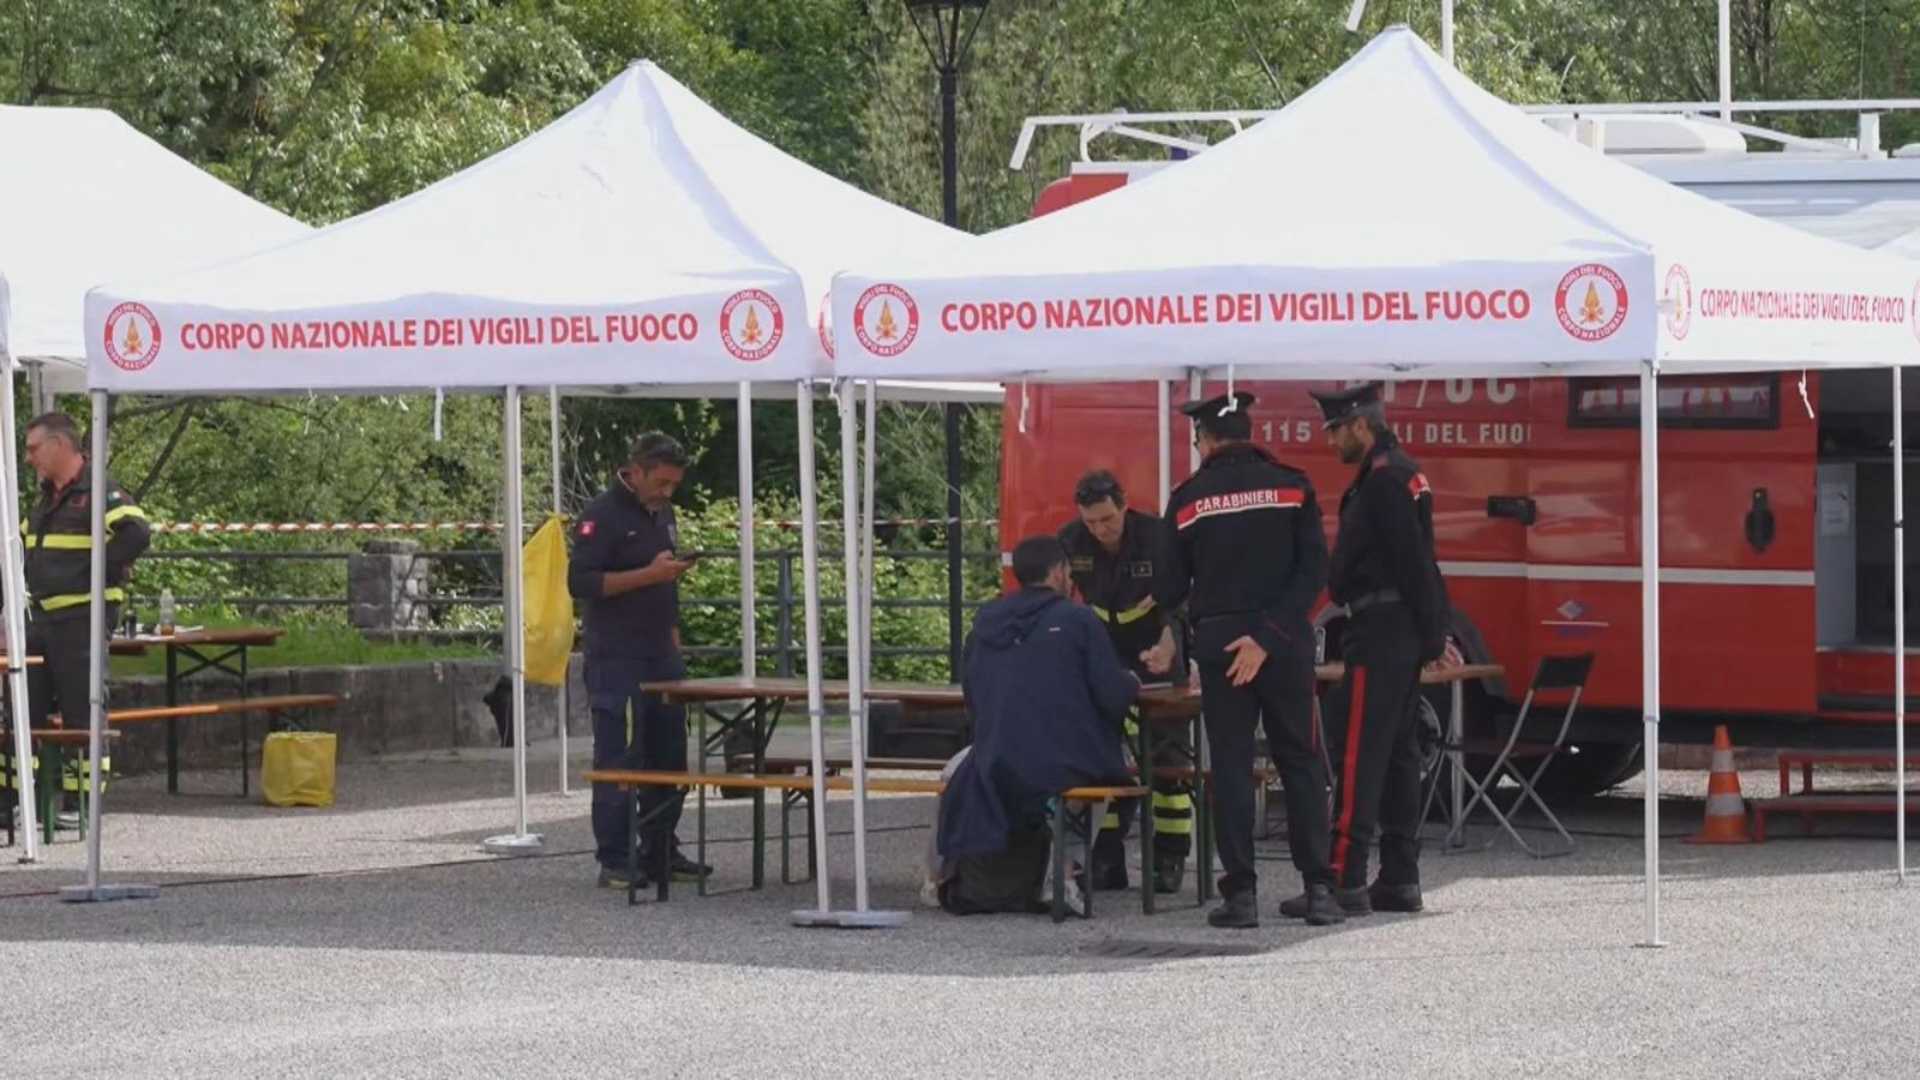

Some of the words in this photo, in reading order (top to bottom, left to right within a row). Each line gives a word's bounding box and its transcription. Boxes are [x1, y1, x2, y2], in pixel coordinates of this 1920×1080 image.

[942, 303, 1036, 331] CORPO
[1045, 295, 1208, 327] NAZIONALE
[1216, 294, 1260, 321] DEI
[1269, 293, 1354, 321] VIGILI
[1363, 292, 1418, 320] DEL
[1426, 289, 1530, 319] FUOCO
[1700, 288, 1738, 317] CORPO
[1741, 291, 1801, 319] NAZIONALE
[1803, 293, 1820, 319] DEI
[1822, 294, 1850, 321] VIGILI
[1852, 295, 1871, 321] DEL
[1872, 297, 1905, 323] FUOCO
[180, 323, 265, 350] CORPO
[271, 320, 417, 349] NAZIONALE
[423, 318, 463, 346] DEI
[470, 317, 544, 345] VIGILI
[551, 316, 599, 343] DEL
[606, 313, 699, 343] FUOCO
[1262, 420, 1312, 442] 115
[1425, 423, 1467, 444] DEL
[1480, 423, 1531, 444] FUO
[1195, 490, 1279, 513] CARABINIERI
